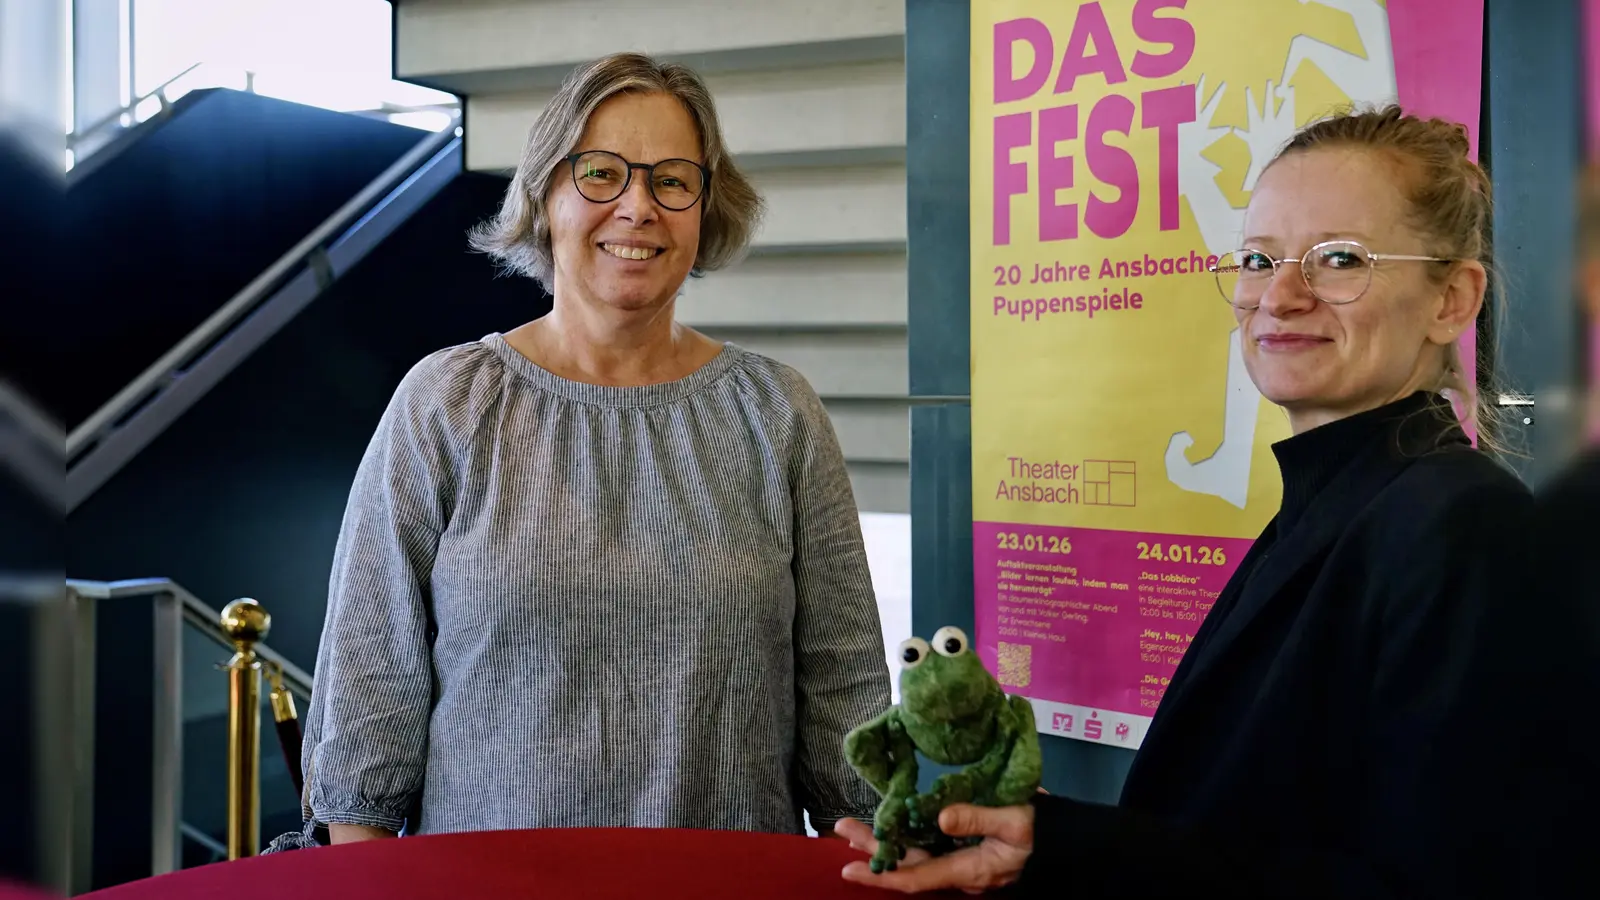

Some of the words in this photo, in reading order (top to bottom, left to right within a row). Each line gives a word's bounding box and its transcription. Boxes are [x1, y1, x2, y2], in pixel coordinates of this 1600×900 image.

[993, 0, 1196, 105] DAS
[993, 84, 1196, 246] FEST
[993, 264, 1021, 286] 20
[1030, 261, 1090, 284] Jahre
[1098, 250, 1219, 280] Ansbache
[993, 287, 1143, 322] Puppenspiele
[1007, 457, 1079, 480] Theater
[995, 480, 1079, 504] Ansbach
[996, 532, 1072, 554] 23.01.26
[1136, 541, 1226, 566] 24.01.26
[996, 559, 1077, 576] Auftaktveranstaltung
[998, 582, 1009, 590] sie
[1025, 573, 1049, 583] lernen
[1052, 575, 1079, 587] laufen,
[1082, 578, 1107, 588] indem
[1110, 582, 1129, 591] man
[1138, 584, 1154, 593] eine
[1156, 585, 1197, 597] interaktive
[1138, 595, 1146, 603] in
[1011, 607, 1024, 615] und
[1038, 608, 1060, 618] Volker
[1092, 602, 1118, 613] Abend
[1140, 607, 1160, 618] 12:00
[1162, 609, 1173, 619] bis
[1010, 616, 1052, 629] Erwachsene
[1023, 629, 1047, 640] Kleines
[1048, 632, 1067, 642] Haus
[1165, 631, 1183, 643] hey,
[1141, 686, 1156, 697] Eine
